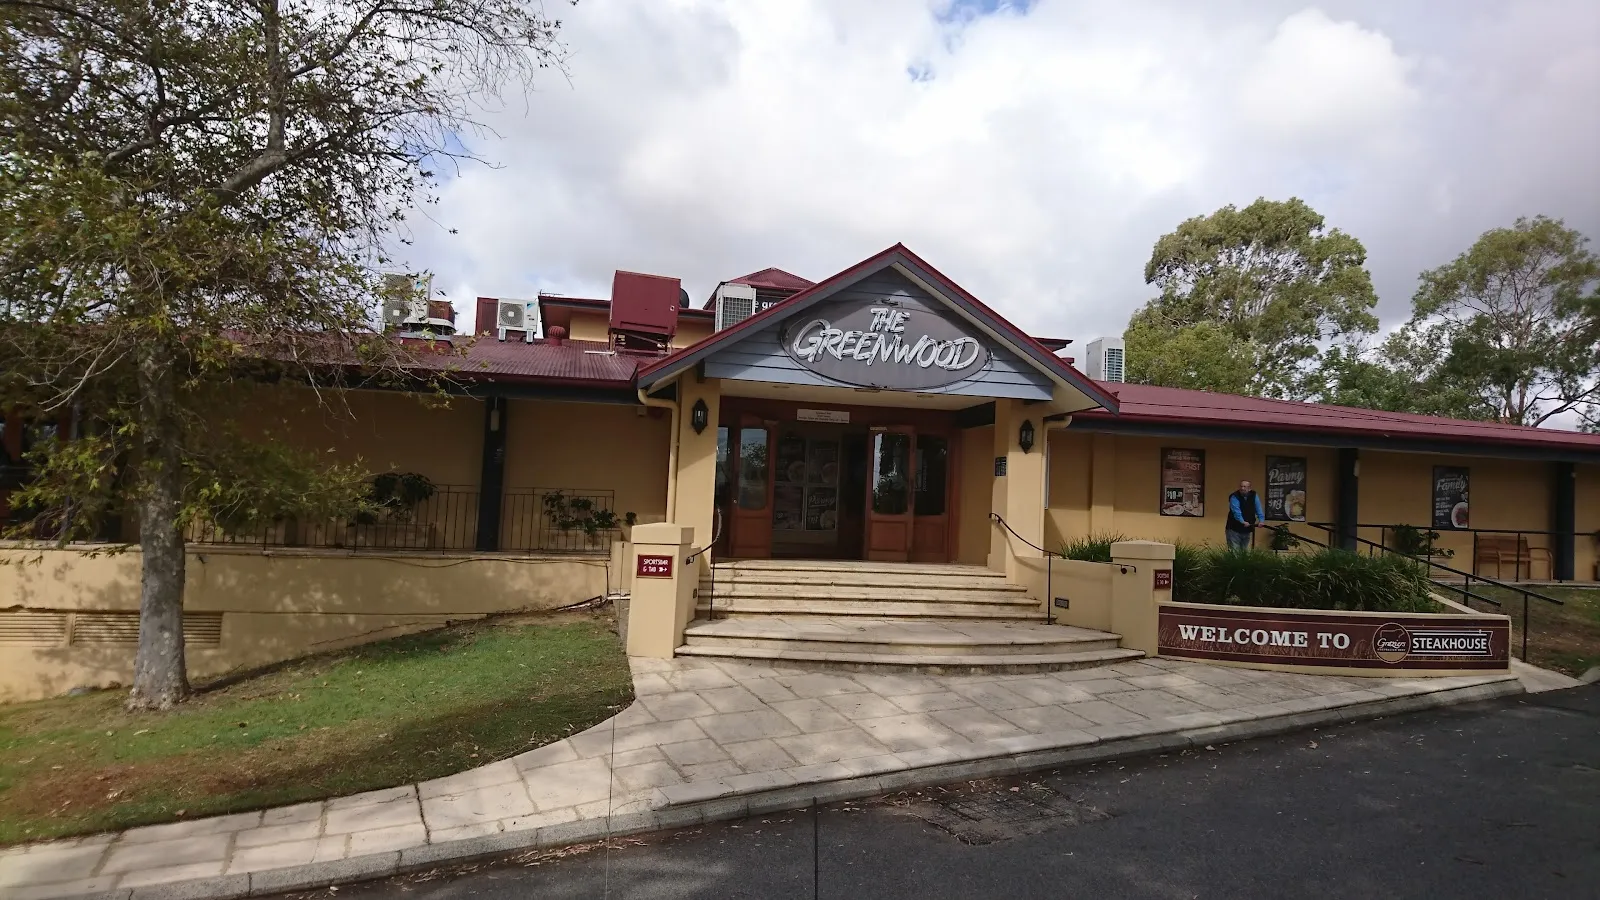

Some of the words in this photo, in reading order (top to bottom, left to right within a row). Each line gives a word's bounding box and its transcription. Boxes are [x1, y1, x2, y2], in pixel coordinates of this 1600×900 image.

[870, 307, 911, 333] THE
[793, 319, 980, 371] GREENWOOD
[1269, 468, 1305, 485] Parmy
[1436, 474, 1467, 493] Family
[643, 558, 669, 566] SPORTSBAR
[1178, 624, 1308, 648] WELCOME
[1317, 632, 1350, 650] TO
[1412, 637, 1488, 650] STEAKHOUSE
